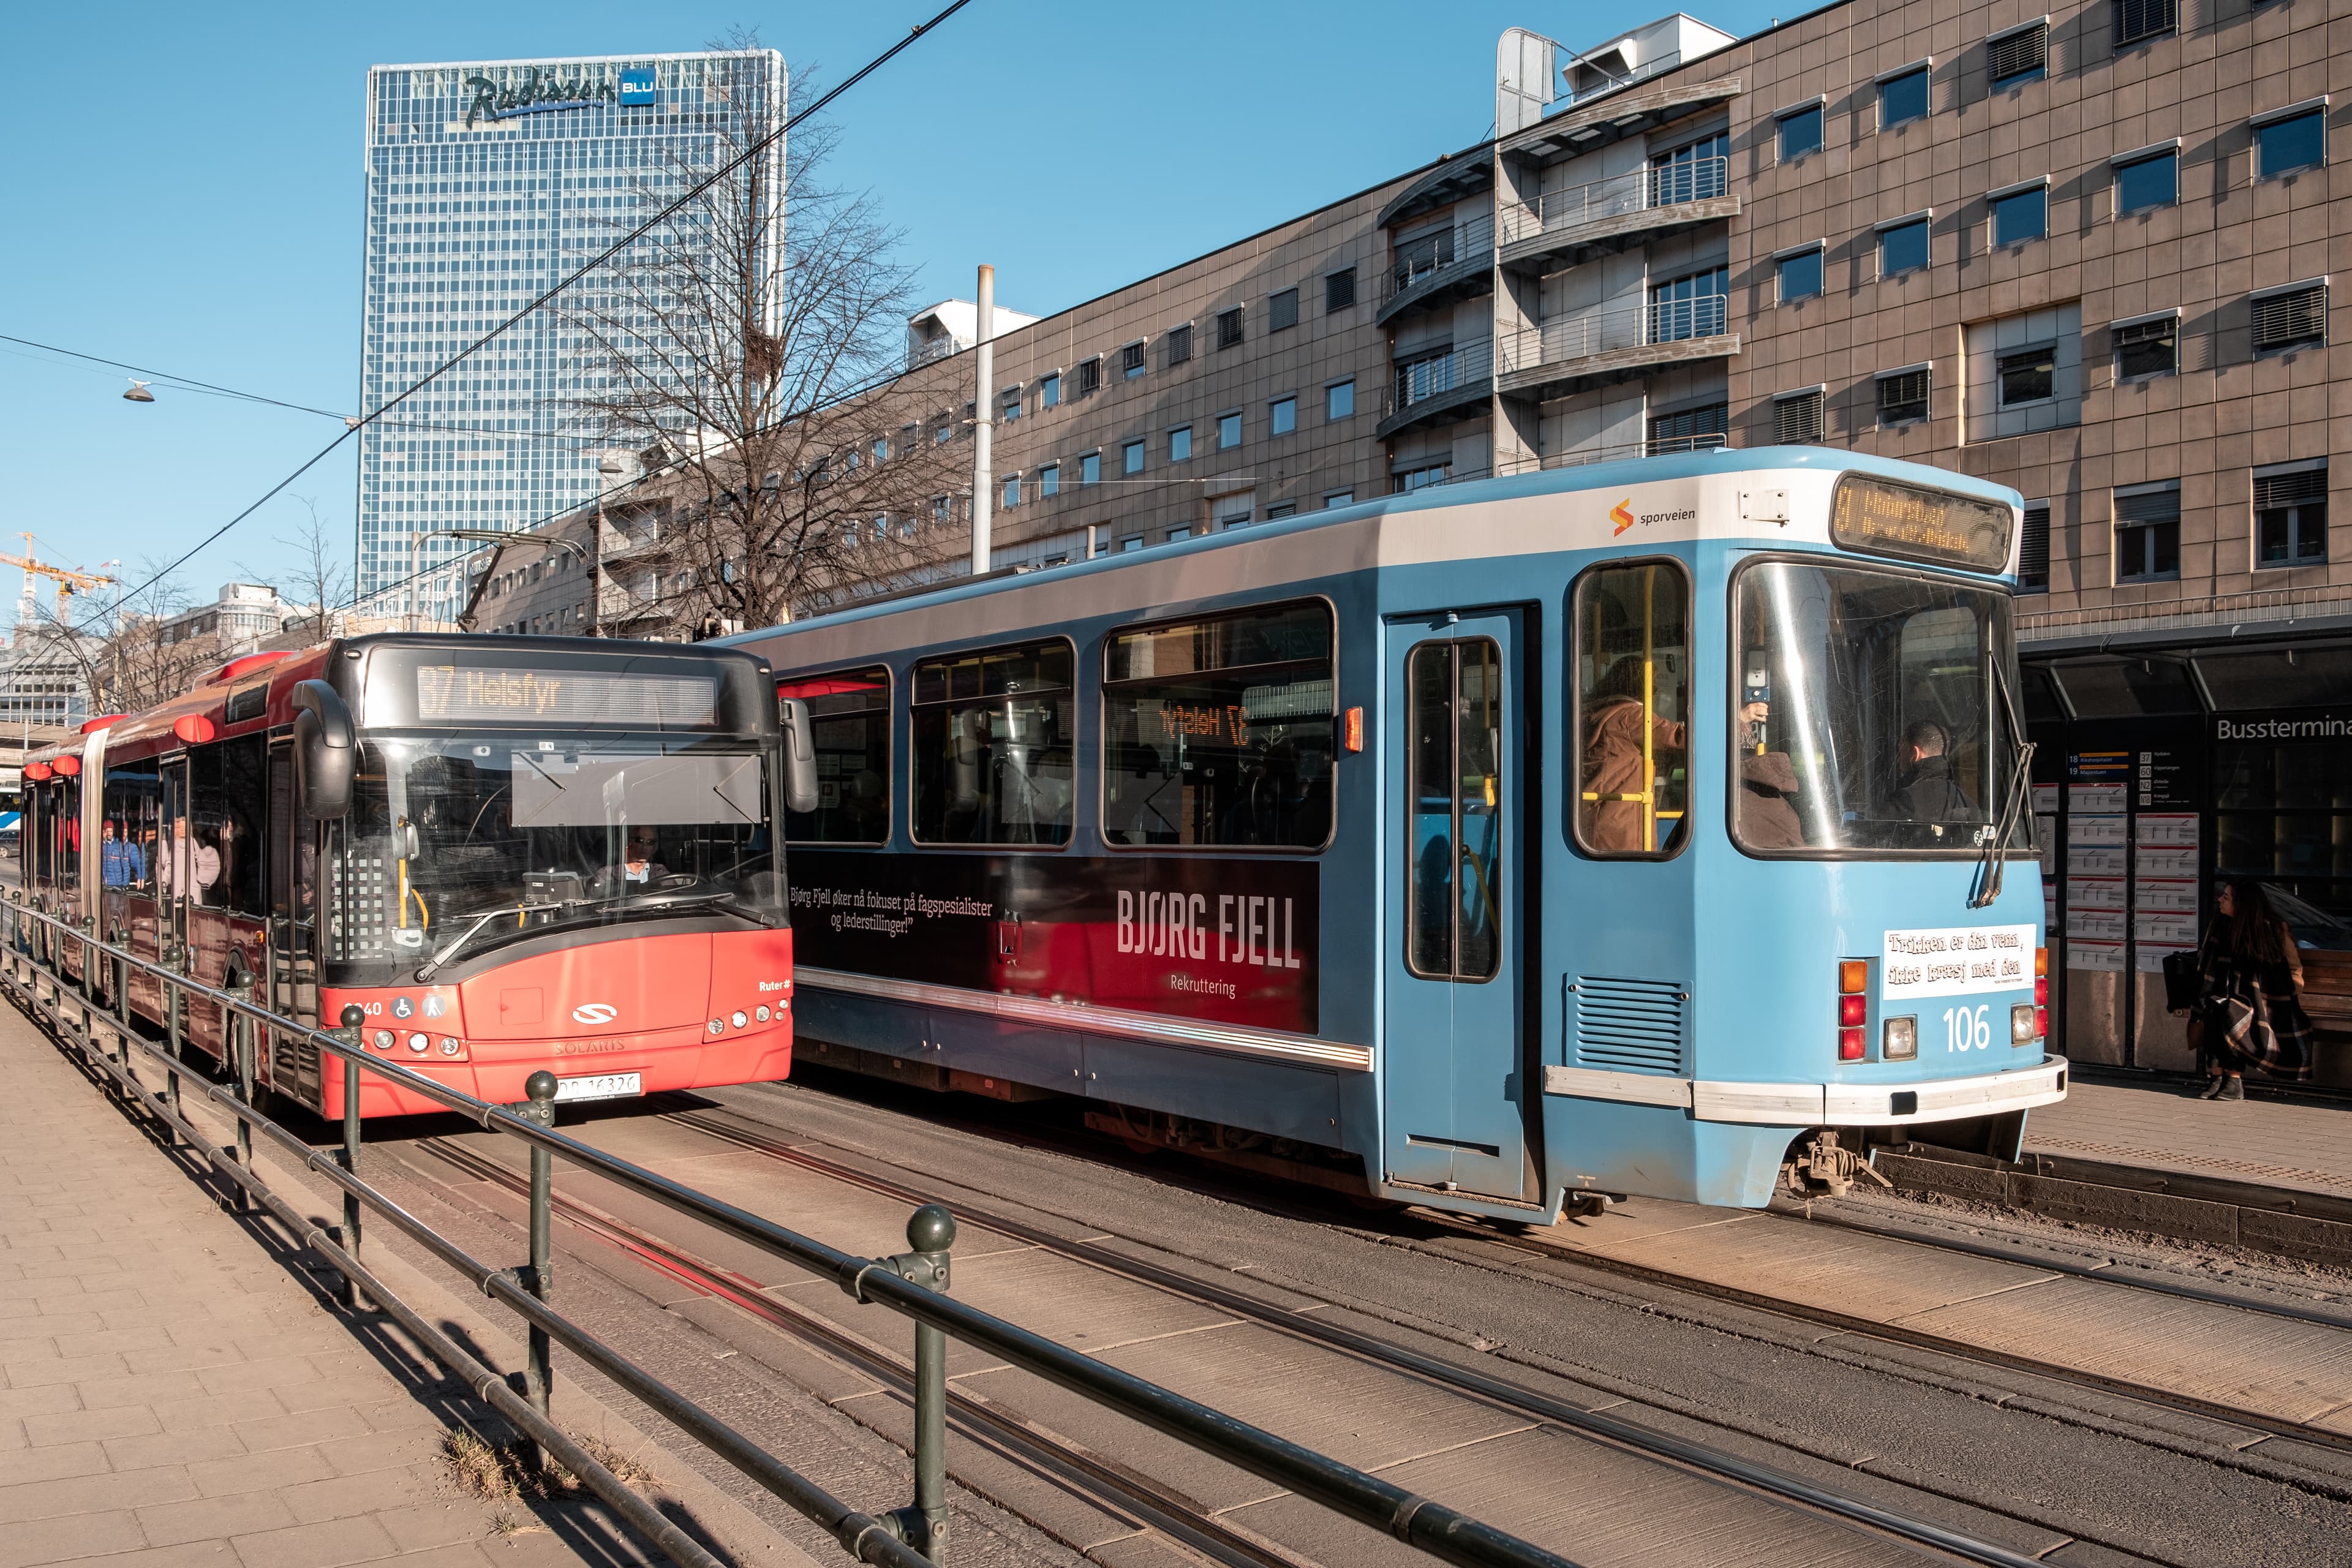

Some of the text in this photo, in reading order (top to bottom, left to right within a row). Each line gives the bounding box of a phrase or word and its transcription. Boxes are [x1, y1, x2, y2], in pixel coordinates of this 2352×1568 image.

[466, 67, 654, 130] Radisson BLU
[1640, 509, 1695, 526] sporveien
[420, 666, 560, 714] 37 Helsfyr
[2141, 754, 2150, 763] 37
[2141, 781, 2150, 790] N2
[2141, 795, 2150, 804] N18
[790, 887, 993, 918] Bjørg Fjell øker nå fokuset på fagspesialister
[831, 914, 842, 932] og
[1118, 890, 1300, 969] BJØRG FJELL
[1889, 933, 1947, 955] Trikken
[1950, 937, 1965, 951] er
[1967, 932, 1988, 951] din
[1888, 958, 2021, 985] ikke kræsj med den
[759, 979, 791, 992] Ruter#
[1170, 974, 1236, 1000] Rekruttering
[344, 1001, 382, 1016] 40
[1943, 1004, 1990, 1053] 106
[556, 1039, 625, 1055] SOLARIS
